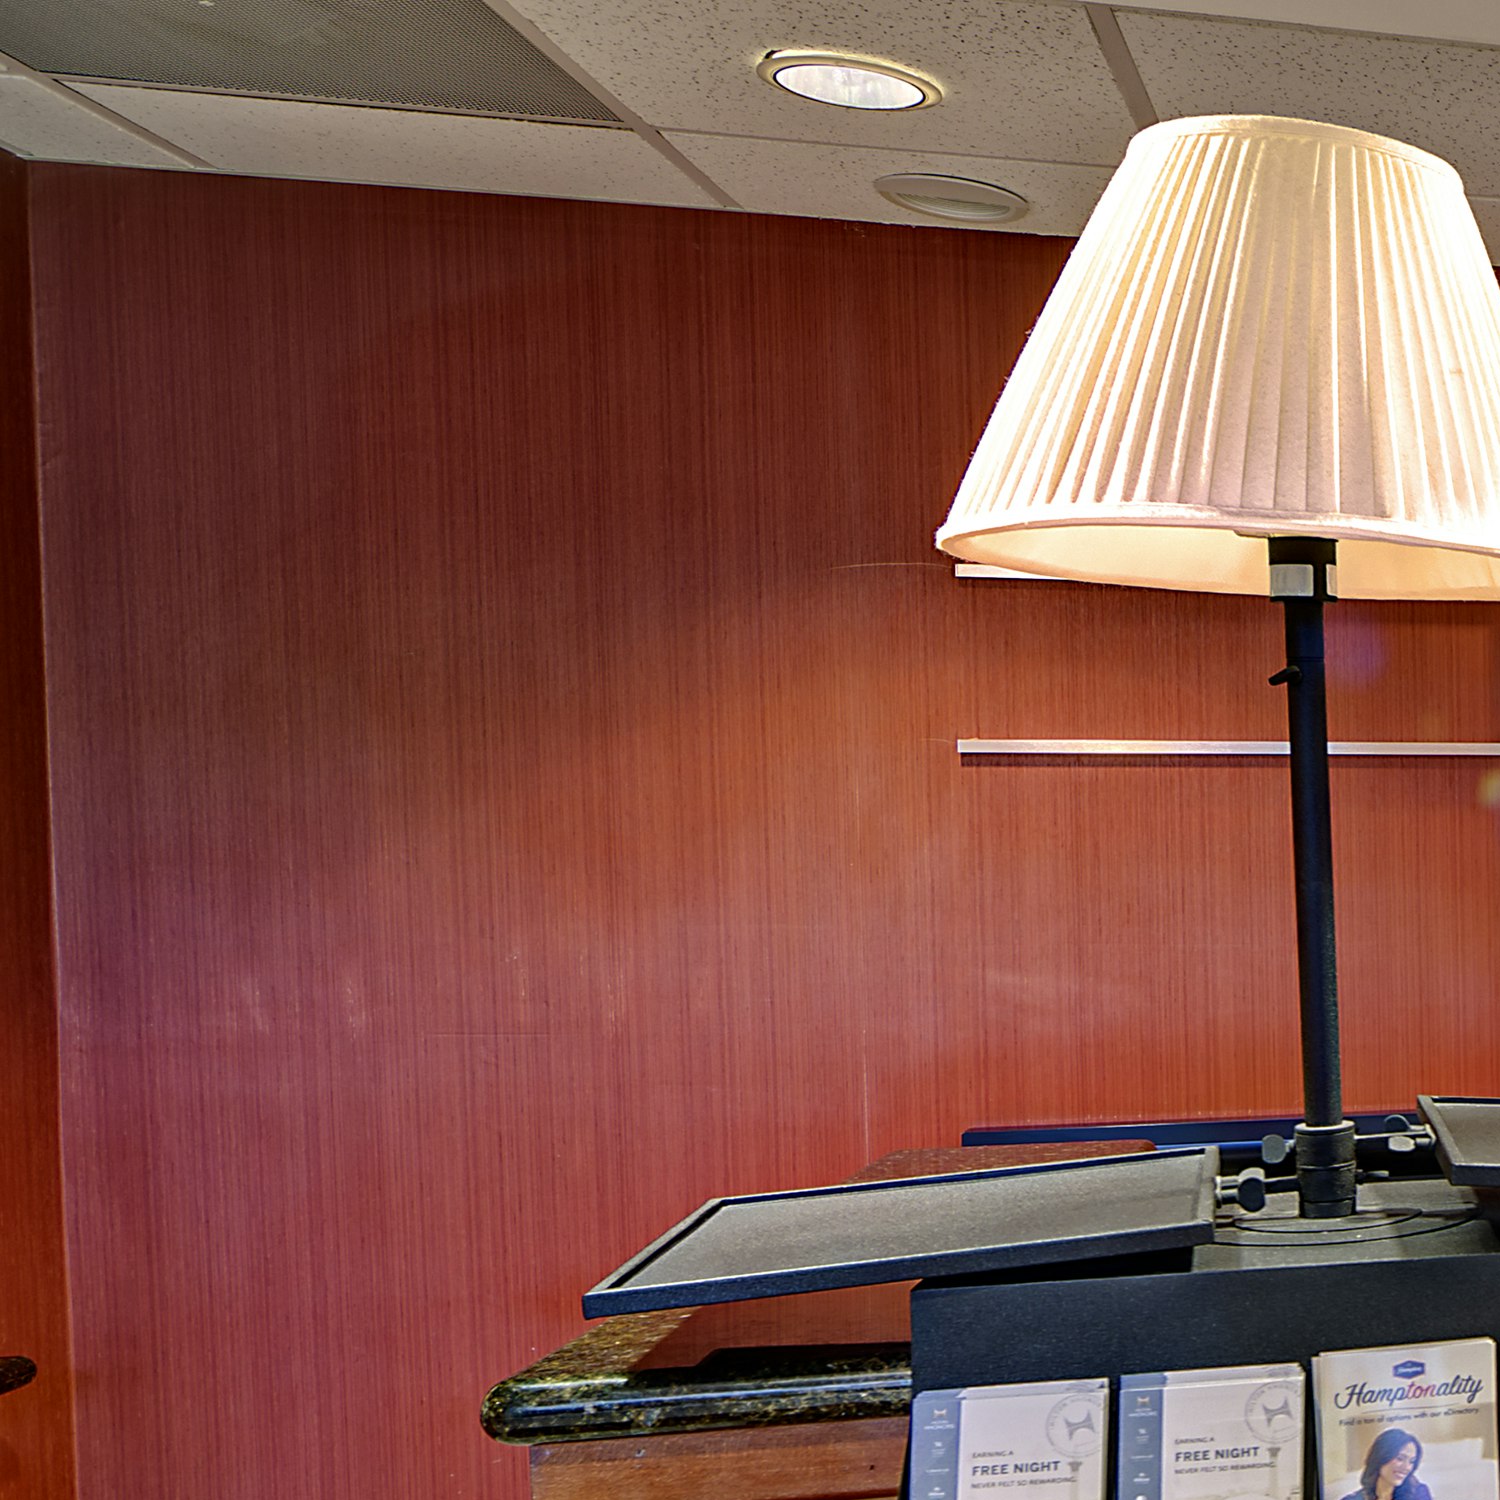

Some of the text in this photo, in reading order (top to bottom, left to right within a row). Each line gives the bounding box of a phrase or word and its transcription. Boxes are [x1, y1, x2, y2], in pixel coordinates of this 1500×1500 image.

[1334, 1374, 1484, 1409] Hamptonality
[1175, 1446, 1260, 1462] FREE NIGHT
[971, 1460, 1061, 1477] FREE NIGHT
